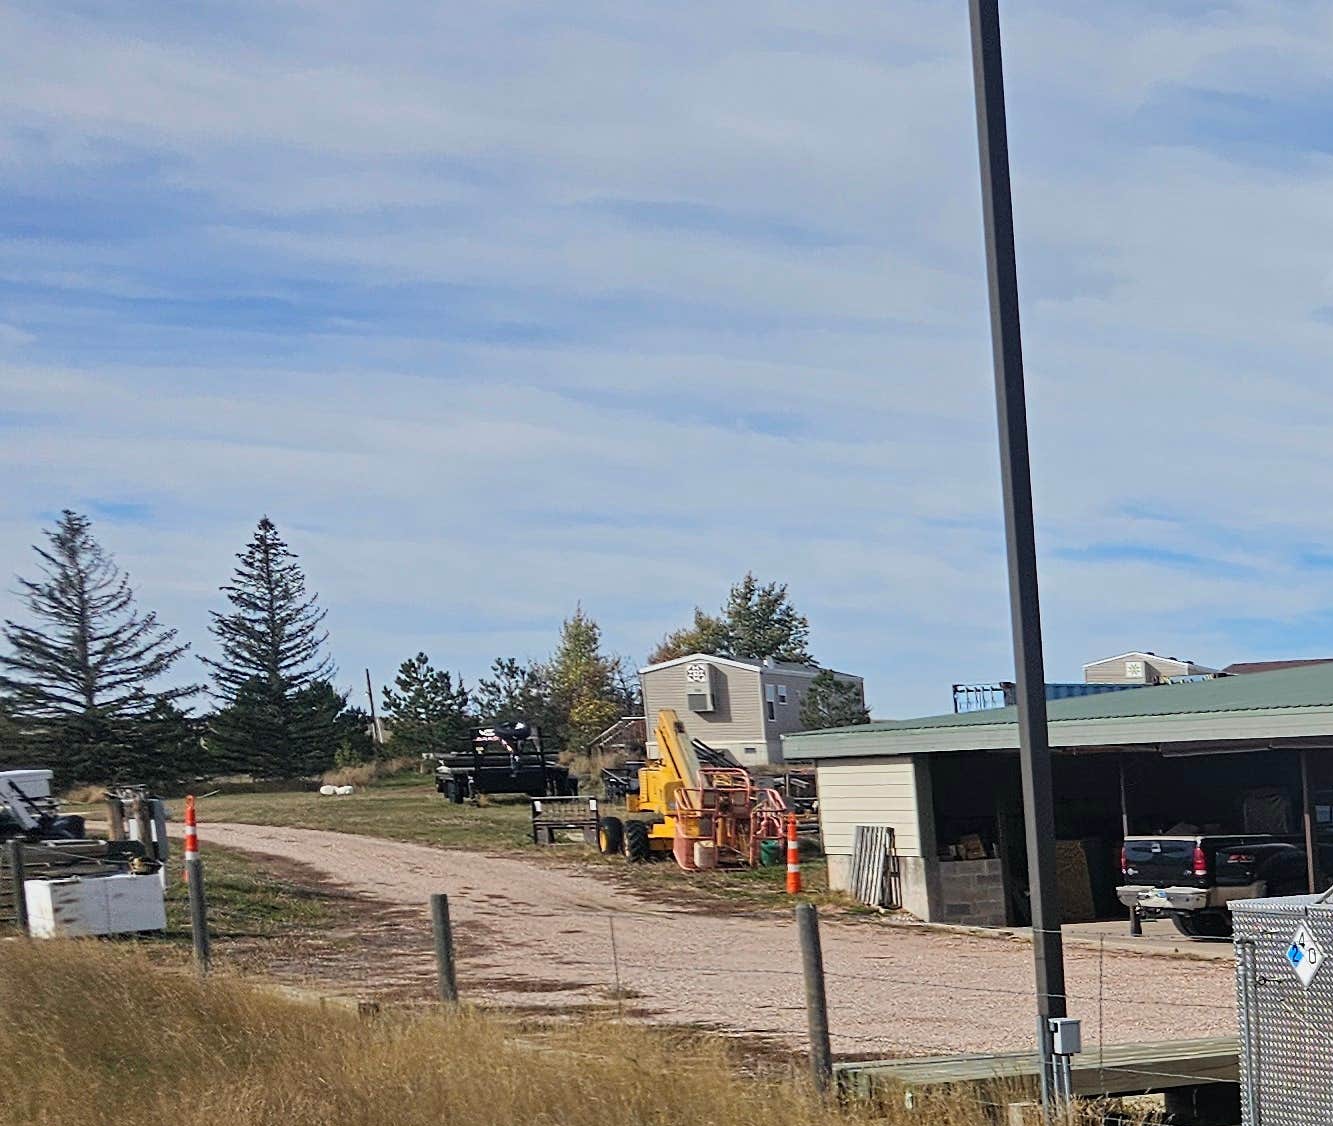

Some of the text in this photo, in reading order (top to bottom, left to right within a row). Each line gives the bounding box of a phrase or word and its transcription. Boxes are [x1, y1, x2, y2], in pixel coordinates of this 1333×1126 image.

[1299, 932, 1305, 948] 4
[1292, 943, 1316, 964] 2 0
